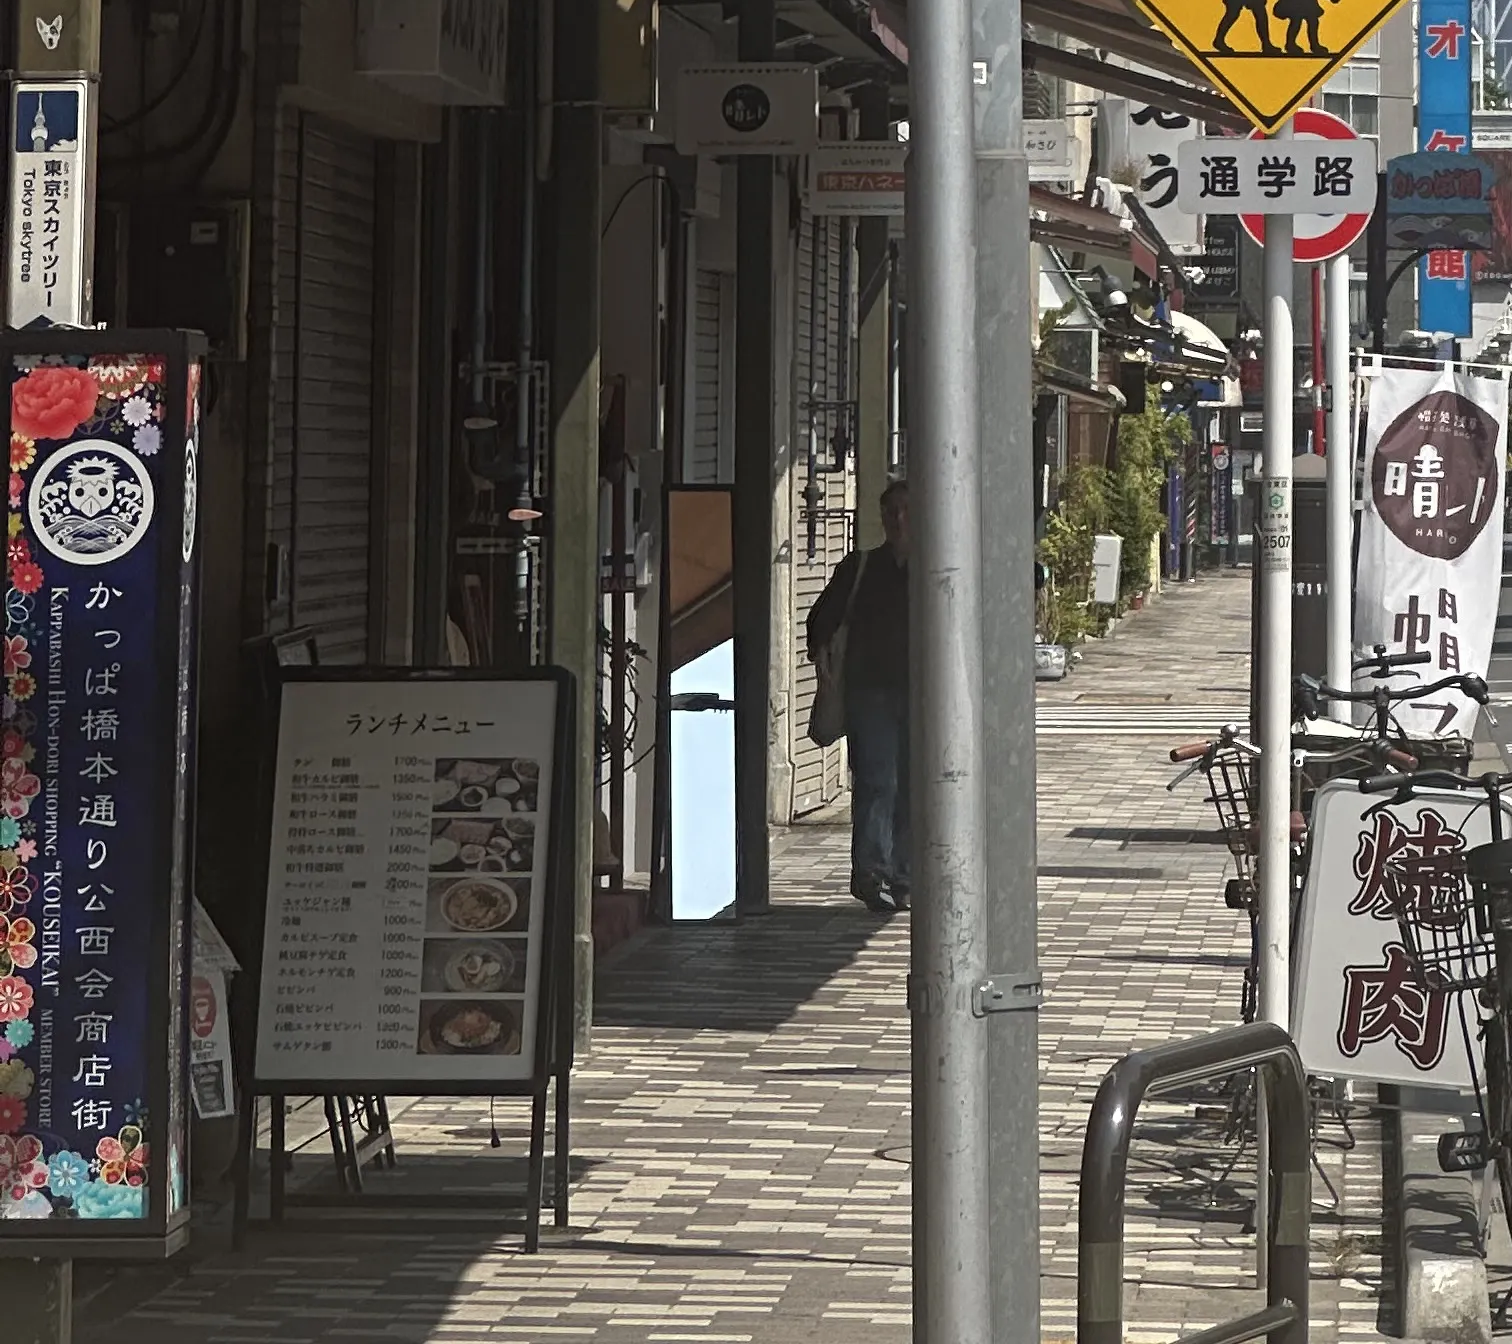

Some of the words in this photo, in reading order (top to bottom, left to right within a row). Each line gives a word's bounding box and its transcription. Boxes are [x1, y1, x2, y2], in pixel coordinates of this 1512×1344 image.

[21, 168, 36, 217] Tokyo
[1200, 156, 1354, 199] 通学路
[43, 159, 63, 308] 東京スカイツリー
[1263, 535, 1291, 549] 2507
[346, 713, 495, 736] ランチメニュー
[44, 778, 60, 856] SHOPPING
[71, 580, 124, 1131] かっぱ橋本通り公西会商店街
[1336, 808, 1465, 1071] 焼肉
[39, 1009, 55, 1074] MEMBER
[39, 1077, 53, 1129] STORE
